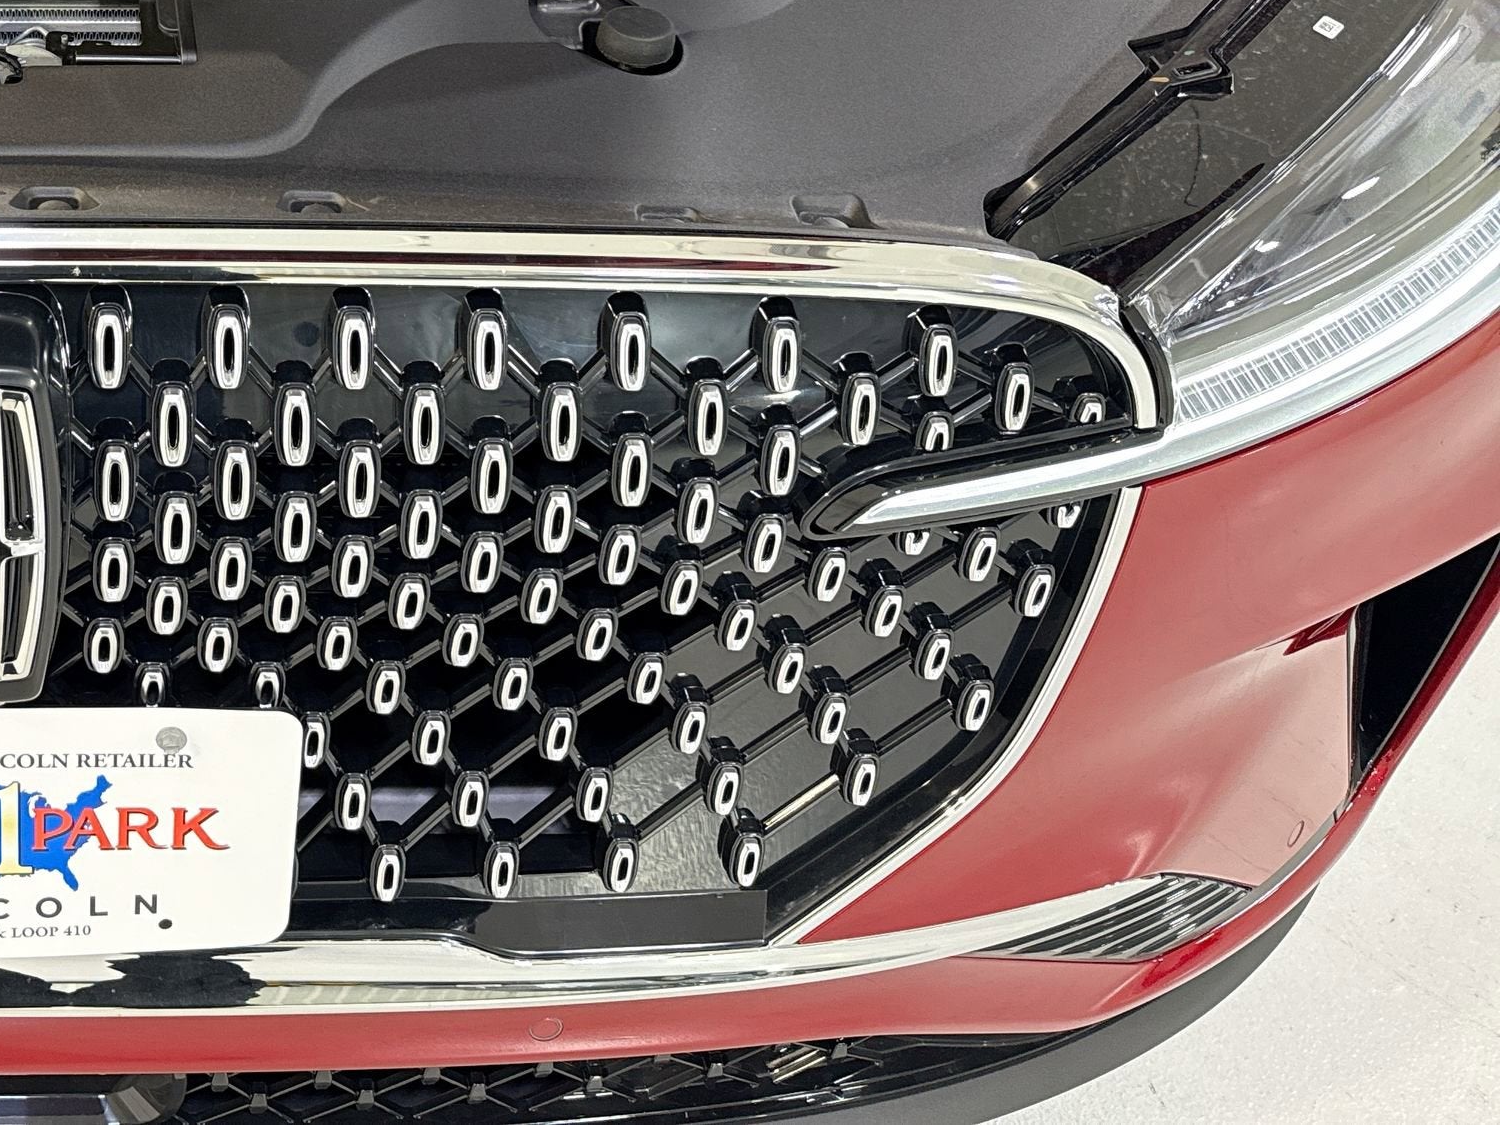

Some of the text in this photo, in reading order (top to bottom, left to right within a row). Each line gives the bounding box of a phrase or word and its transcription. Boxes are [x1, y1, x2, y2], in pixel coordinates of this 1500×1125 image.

[76, 752, 194, 770] RETAILER
[32, 807, 230, 852] PARK
[11, 926, 59, 939] LOOP
[63, 925, 92, 937] 410
